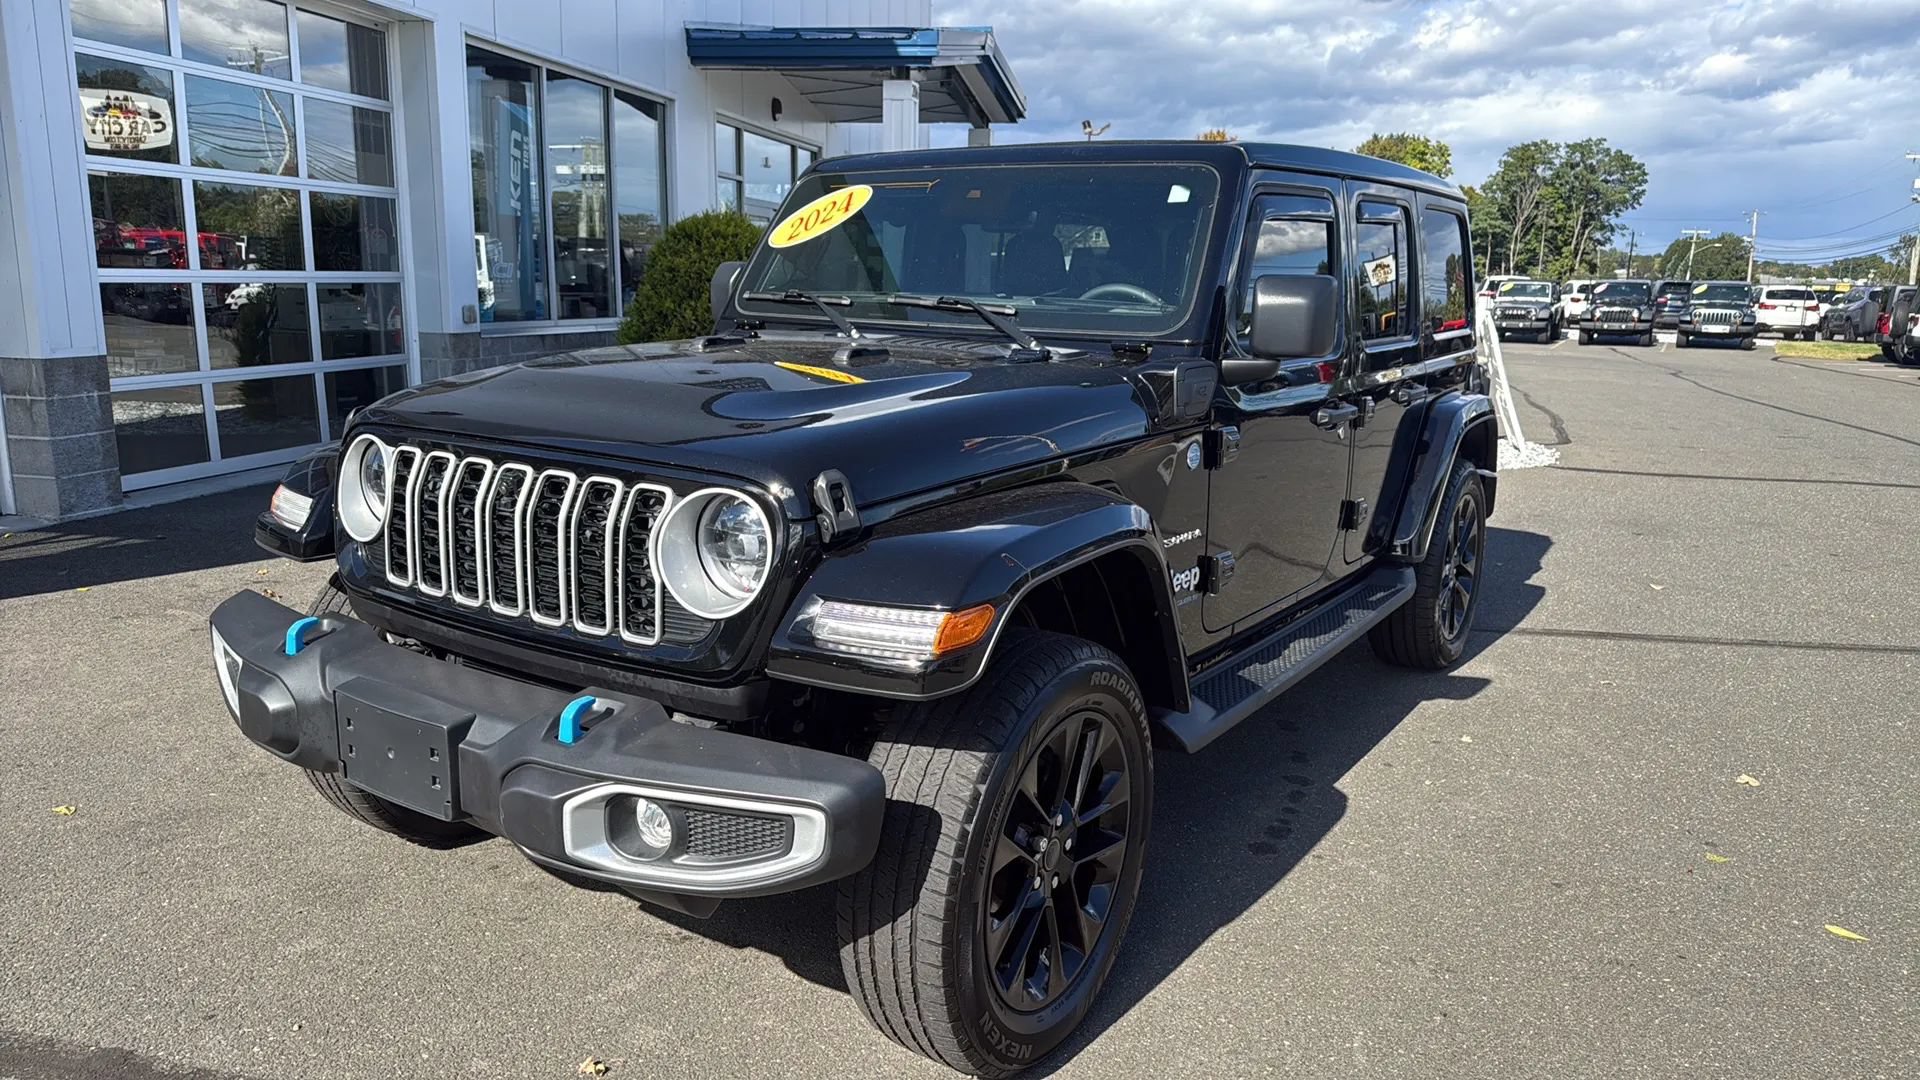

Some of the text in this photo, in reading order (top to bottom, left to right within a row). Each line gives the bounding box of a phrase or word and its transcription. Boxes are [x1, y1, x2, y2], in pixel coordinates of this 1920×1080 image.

[510, 129, 522, 217] KEN
[522, 136, 530, 169] TIRES
[787, 192, 854, 241] 2024
[1090, 671, 1142, 713] ROADIAN
[978, 1010, 1033, 1060] NEXEN
